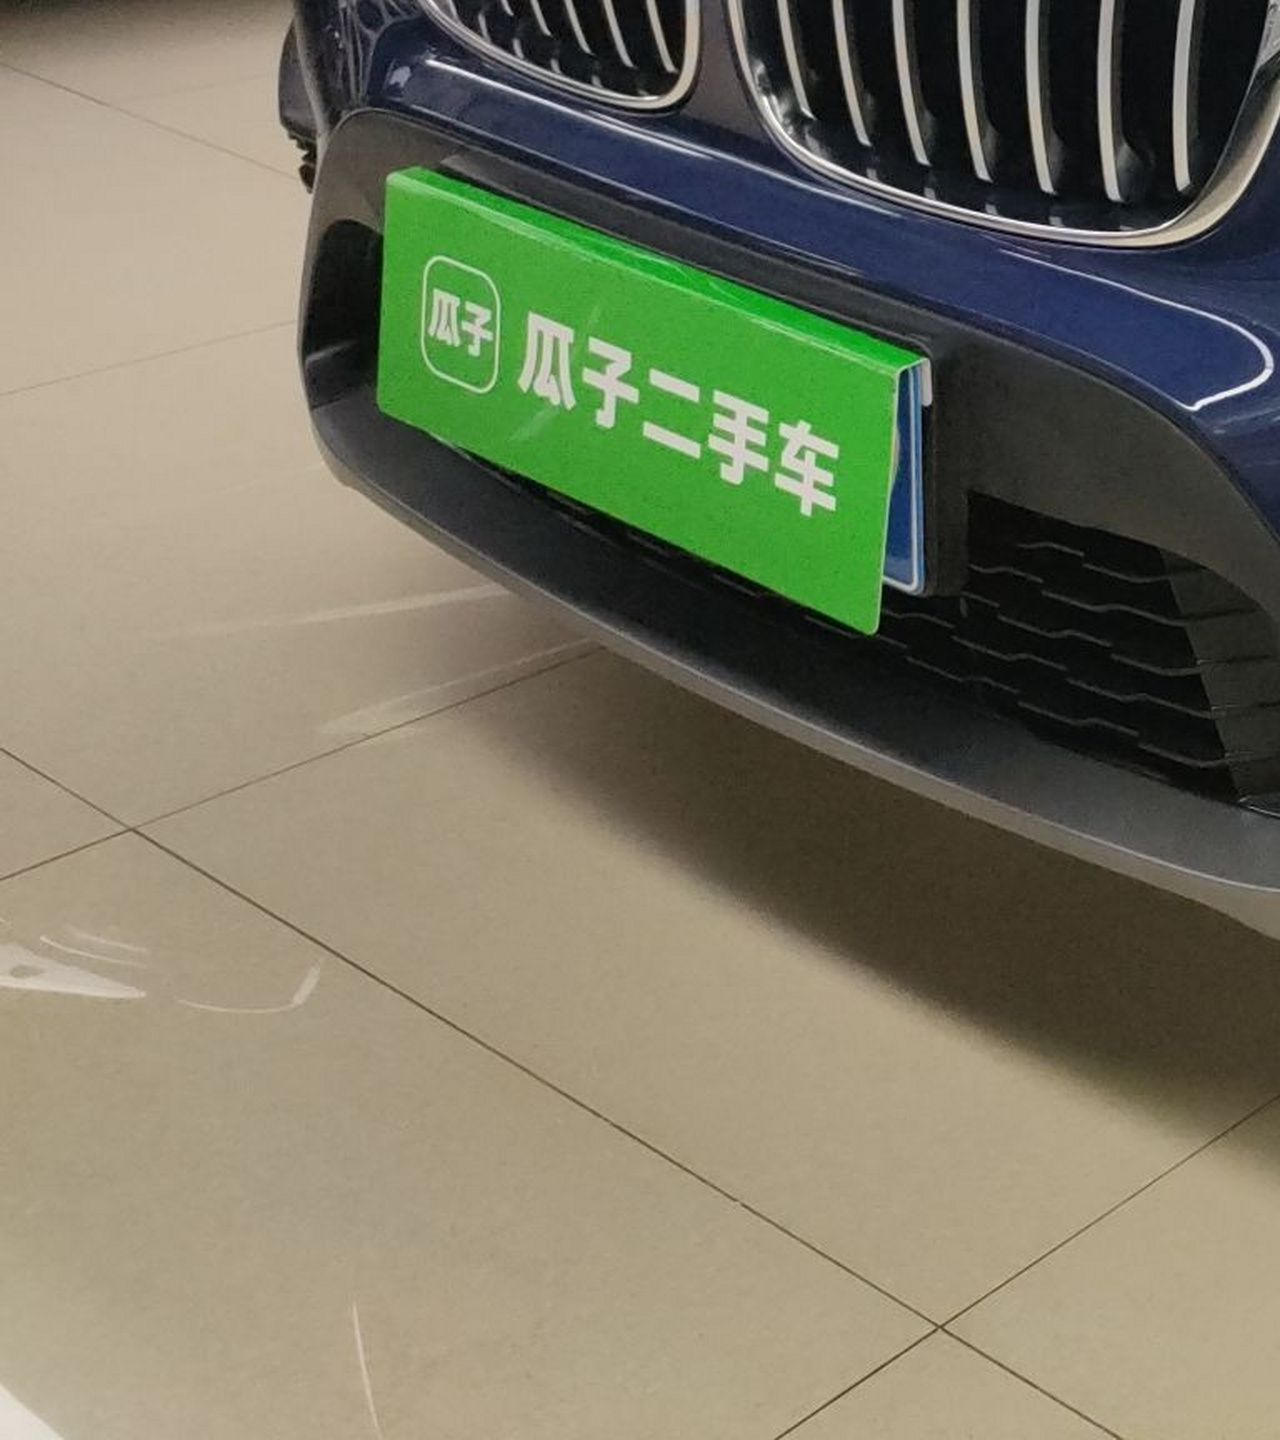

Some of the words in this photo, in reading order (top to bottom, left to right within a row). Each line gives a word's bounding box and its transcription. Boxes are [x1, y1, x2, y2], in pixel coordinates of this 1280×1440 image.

[429, 288, 494, 357] 瓜子
[518, 311, 840, 517] 瓜子二手车
